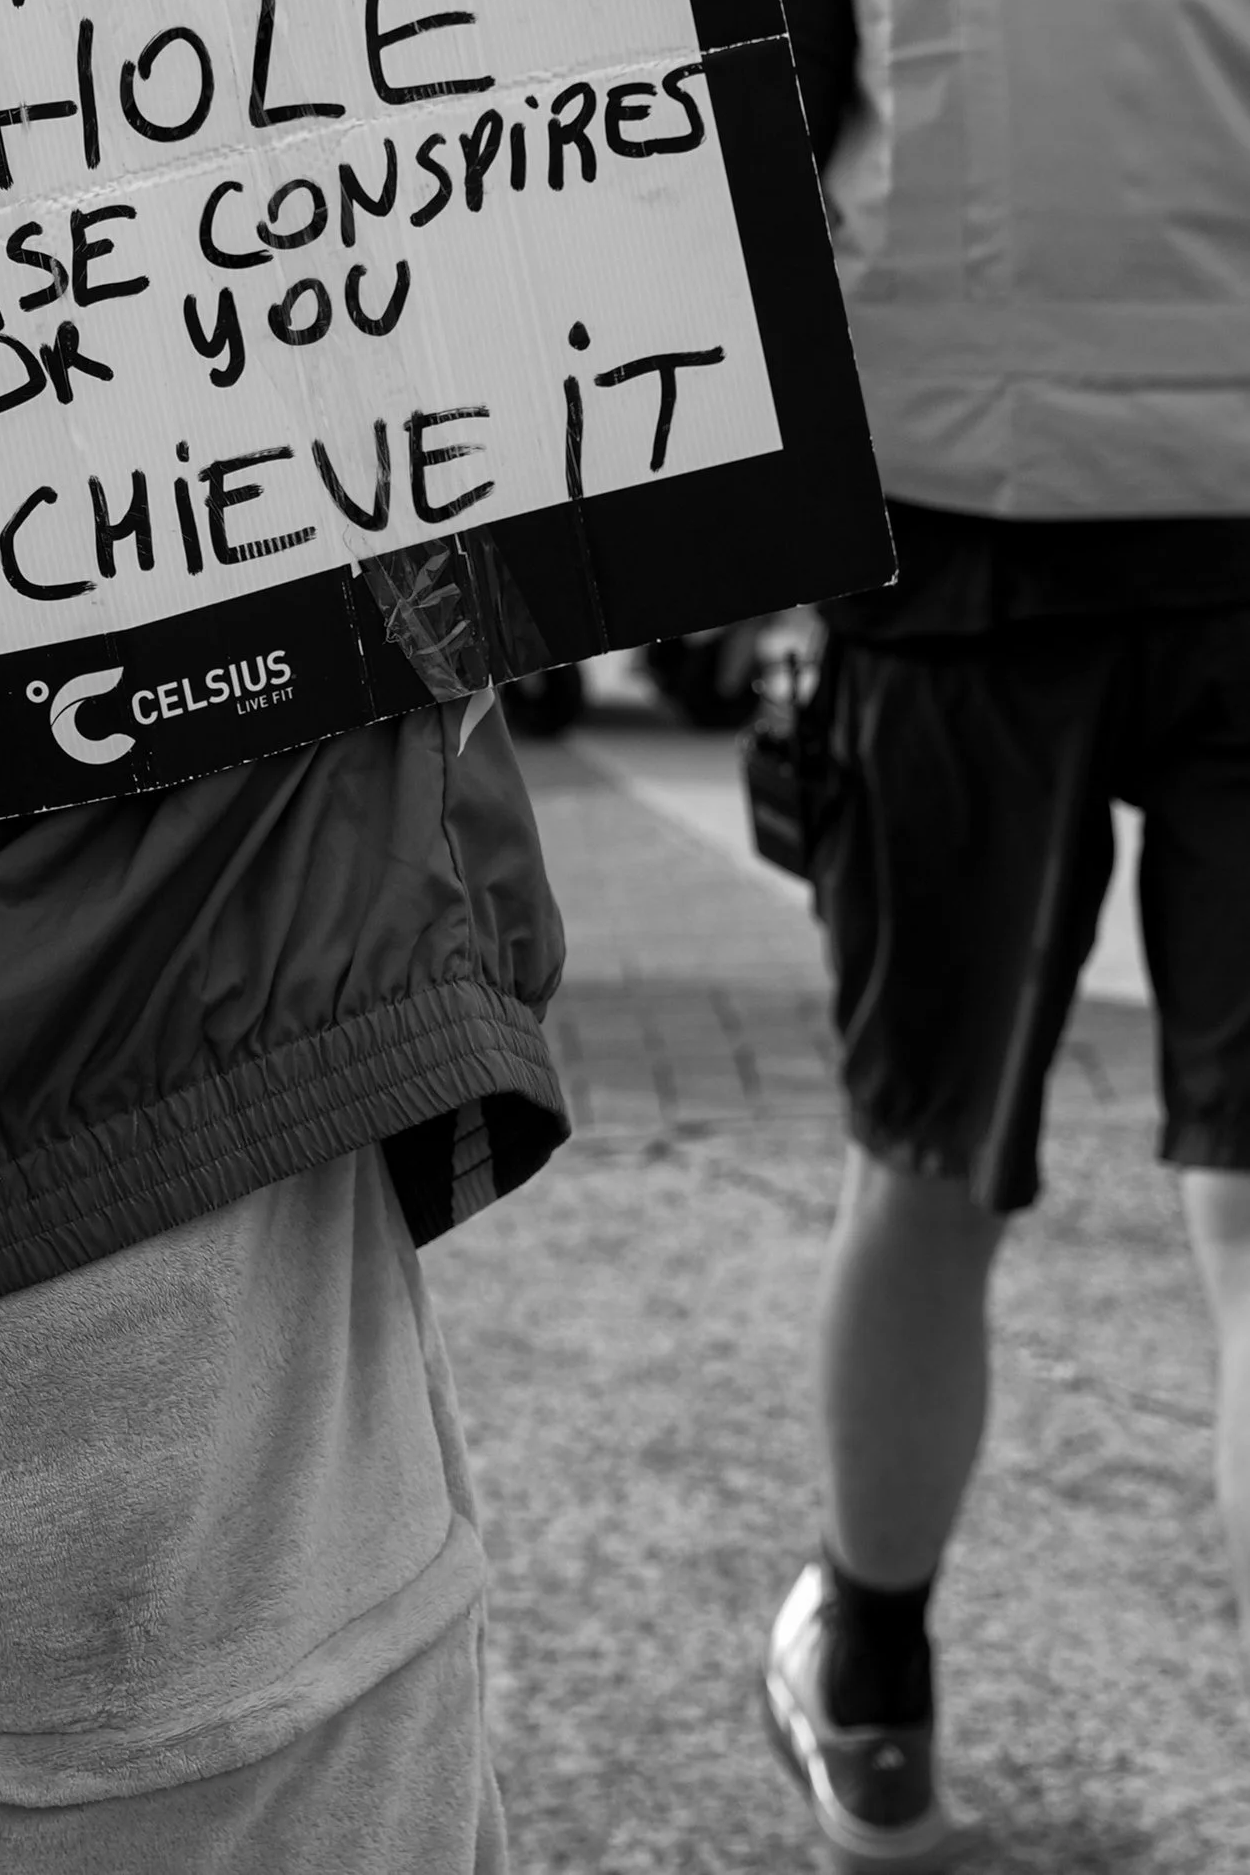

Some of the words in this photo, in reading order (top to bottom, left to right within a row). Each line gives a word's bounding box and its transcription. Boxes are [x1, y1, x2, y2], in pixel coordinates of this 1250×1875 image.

[131, 649, 292, 725] CELSIUS
[236, 694, 269, 715] LIVE
[273, 686, 295, 703] FIT
